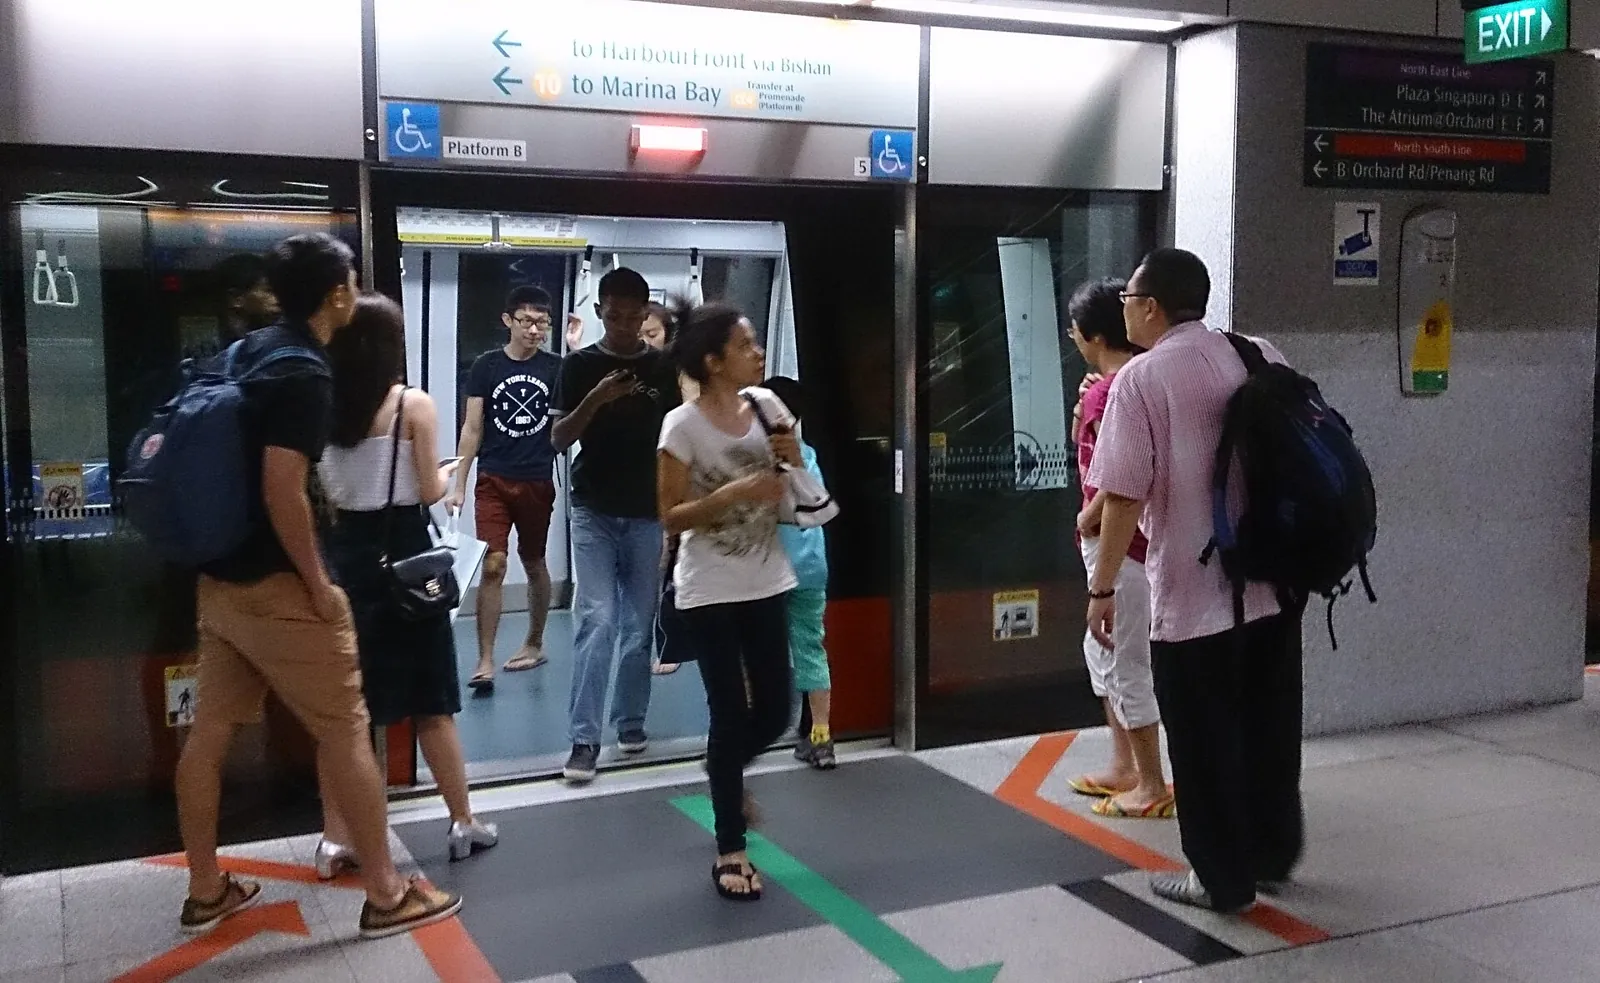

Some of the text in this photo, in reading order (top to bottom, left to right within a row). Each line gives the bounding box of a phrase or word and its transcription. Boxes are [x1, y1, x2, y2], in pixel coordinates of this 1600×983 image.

[1479, 7, 1536, 52] EXIT
[573, 38, 832, 76] to HarbourFront via Bishan
[1400, 63, 1472, 78] North East Line
[534, 73, 561, 95] 10
[572, 74, 594, 95] to
[602, 75, 676, 100] Marina
[685, 81, 722, 107] Bay
[747, 81, 794, 92] Transfer at
[758, 92, 806, 102] Promenade
[1397, 84, 1430, 101] Plaza
[1434, 86, 1495, 107] Singapura
[758, 102, 793, 111] (Platform
[1362, 107, 1385, 123] The
[448, 141, 522, 157] Platform B
[1393, 141, 1472, 155] North South Line
[859, 160, 867, 174] 5
[1337, 161, 1495, 185] B Orchard Rd/Penang Rd
[493, 382, 505, 399] NEW
[506, 375, 526, 385] YORK
[520, 388, 526, 396] Y
[494, 417, 507, 432] NEW
